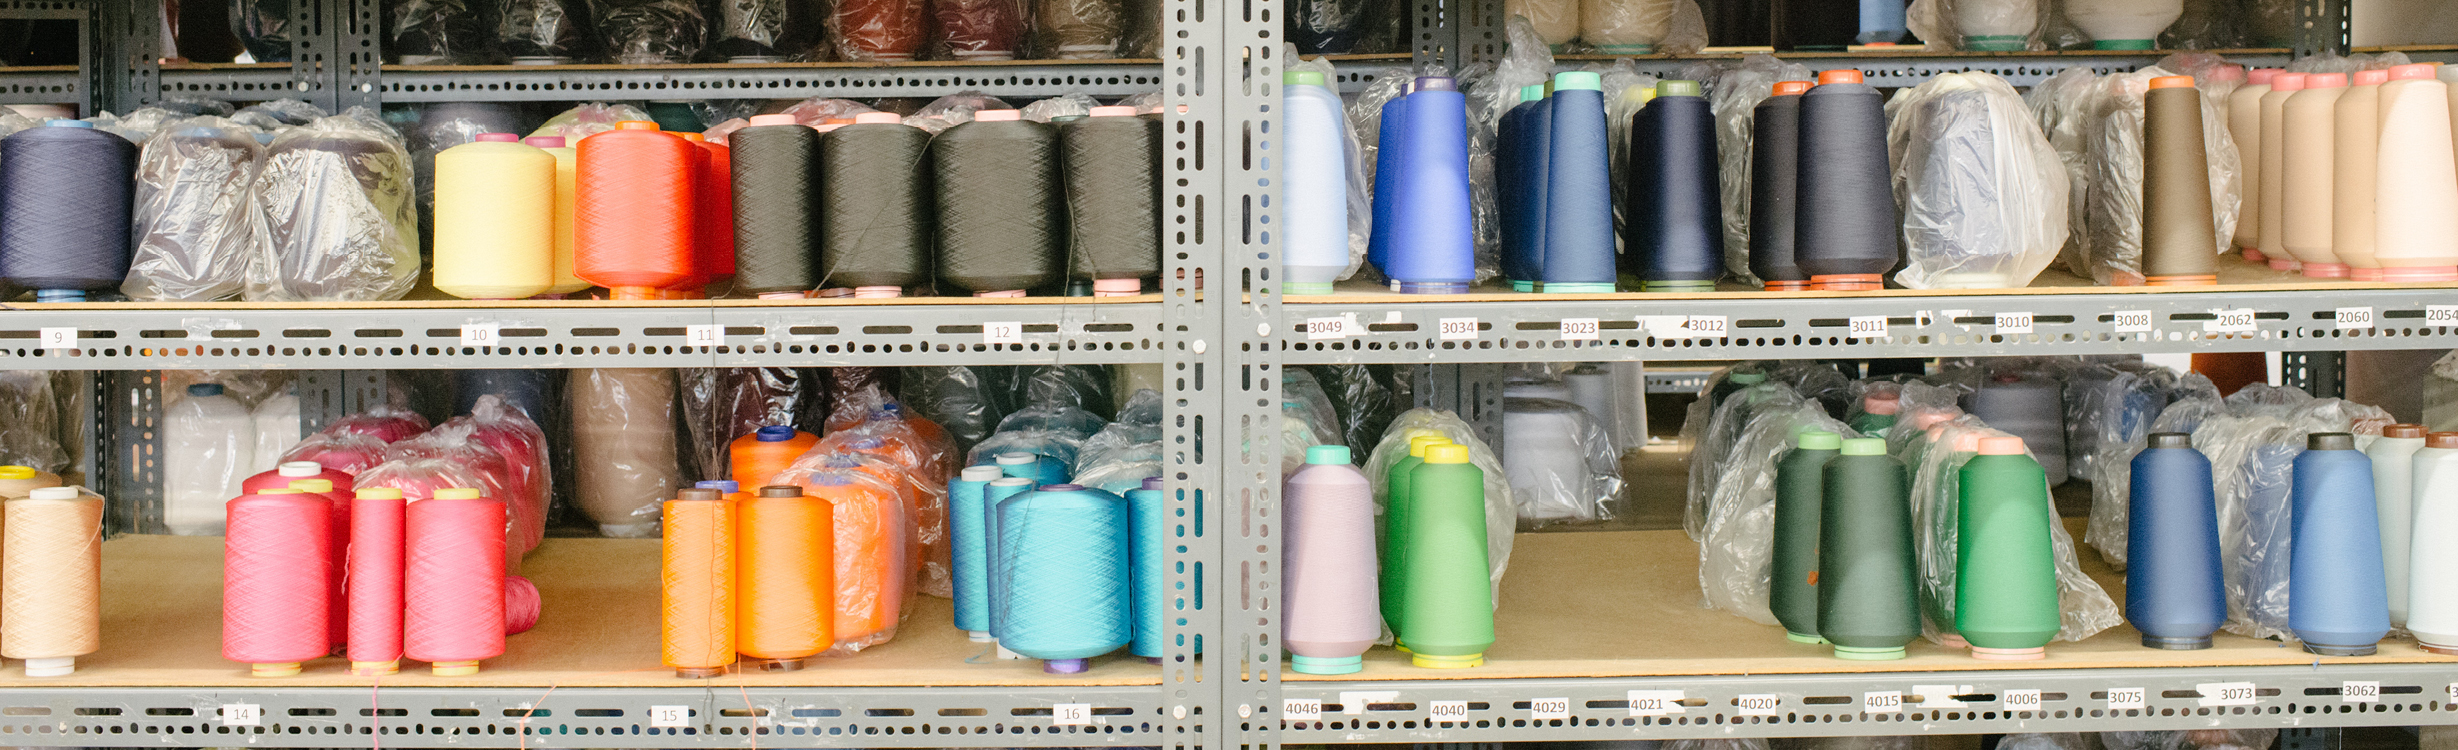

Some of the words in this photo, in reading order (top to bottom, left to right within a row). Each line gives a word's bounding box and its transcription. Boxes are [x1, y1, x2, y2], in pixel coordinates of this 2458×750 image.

[1997, 316, 2030, 329] 3010
[2117, 314, 2149, 327] 3008
[2220, 313, 2252, 327] 2062
[2338, 311, 2370, 323] 2060
[995, 326, 1010, 338] 12
[1309, 321, 1342, 334] 3049
[1442, 321, 1475, 334] 3034
[1563, 322, 1596, 334] 3023
[1691, 319, 1724, 332] 3012
[1852, 320, 1885, 333] 3011
[472, 329, 487, 341] 10
[698, 329, 713, 341] 11
[2110, 691, 2142, 704] 3075
[2221, 687, 2253, 700] 3073
[2344, 685, 2376, 697] 3062
[1630, 698, 1663, 711] 4021
[1740, 698, 1773, 710] 4020
[1866, 695, 1899, 708] 4015
[2005, 693, 2038, 705] 4006
[234, 708, 249, 720] 14
[1065, 708, 1080, 720] 16
[1285, 703, 1319, 715] 4046
[1431, 704, 1465, 717] 4040
[1532, 701, 1566, 714] 4029
[662, 710, 677, 722] 15
